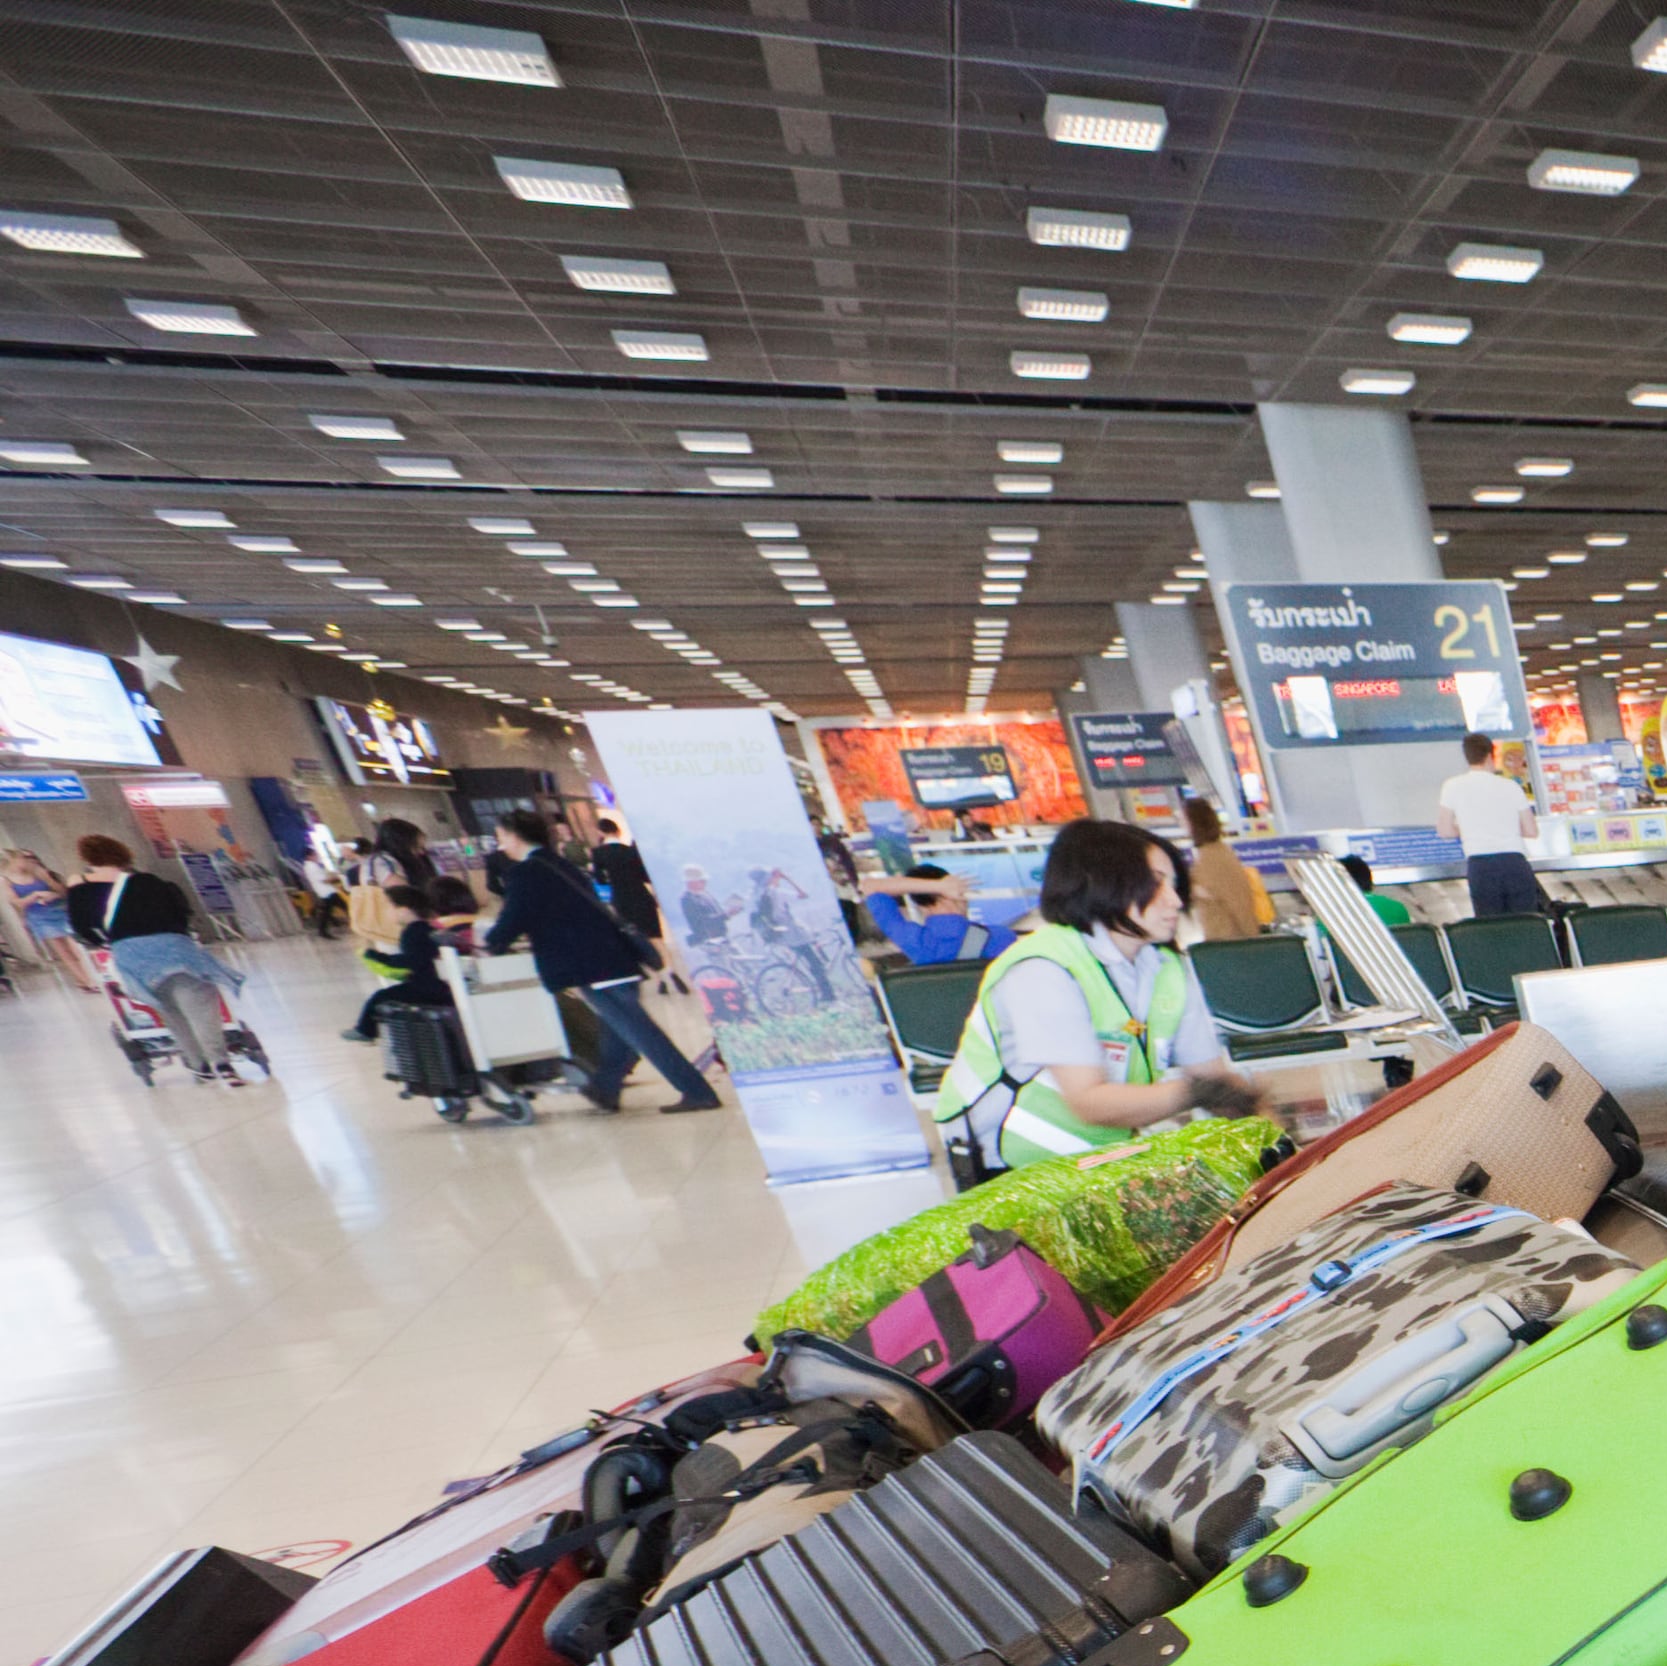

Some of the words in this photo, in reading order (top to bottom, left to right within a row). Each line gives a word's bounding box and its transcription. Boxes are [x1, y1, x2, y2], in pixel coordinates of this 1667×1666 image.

[1433, 603, 1500, 660] 21
[1256, 642, 1351, 668] Baggage
[1355, 639, 1416, 662] Claim
[1333, 680, 1400, 697] SINGAPORE
[979, 753, 1007, 774] 19
